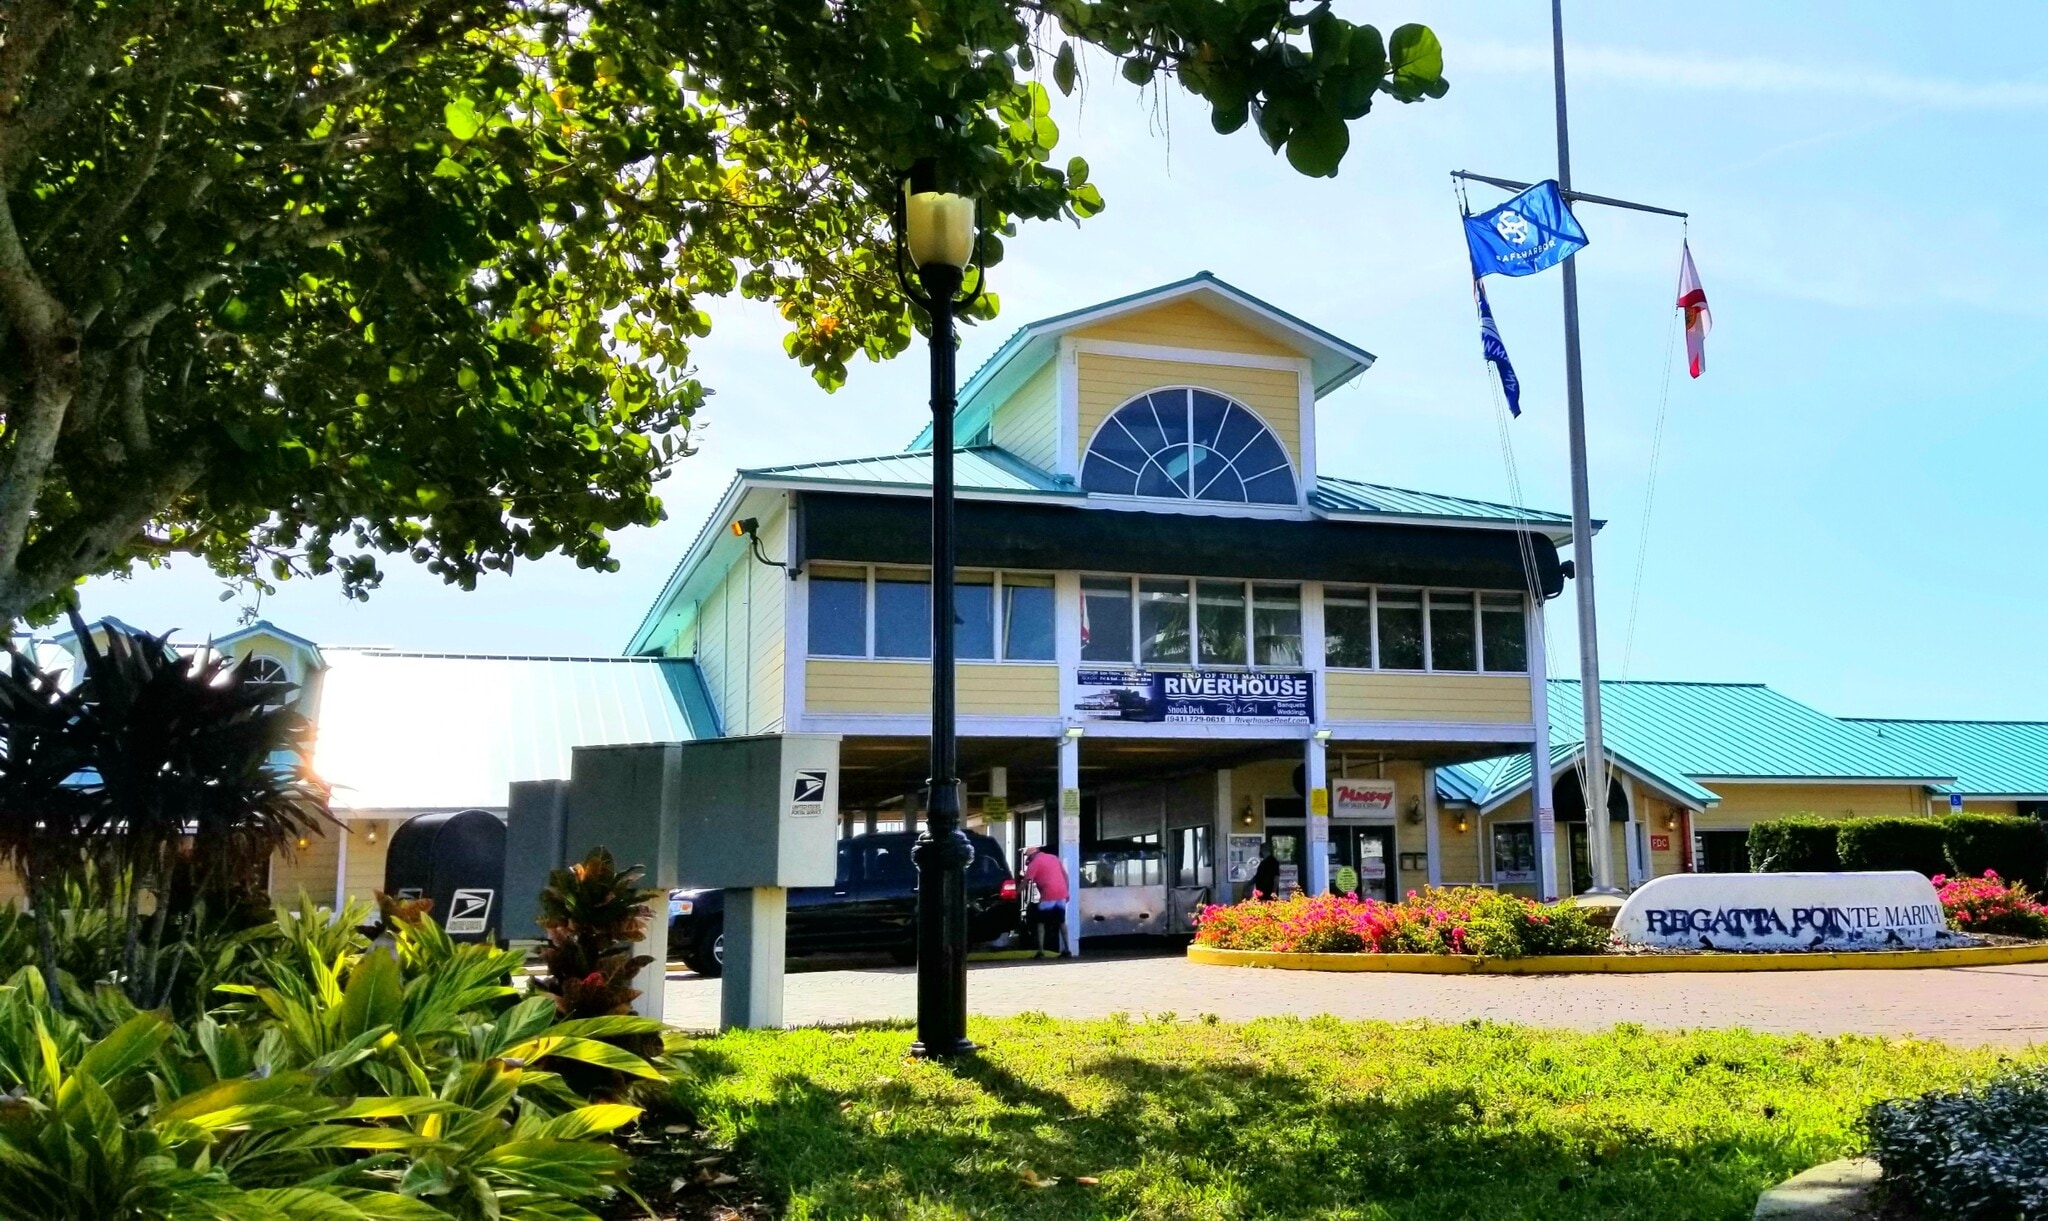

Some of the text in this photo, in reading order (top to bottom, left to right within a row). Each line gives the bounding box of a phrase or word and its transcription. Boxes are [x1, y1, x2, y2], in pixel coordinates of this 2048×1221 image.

[1164, 677, 1307, 695] RIVERHOUSE
[1167, 705, 1205, 714] Snook Deck
[1167, 715, 1187, 723] (941)
[1235, 716, 1308, 724] RiverhouseReef.com
[1652, 838, 1668, 848] FDC
[1645, 904, 1942, 936] REGATTA POINTE MARINA
